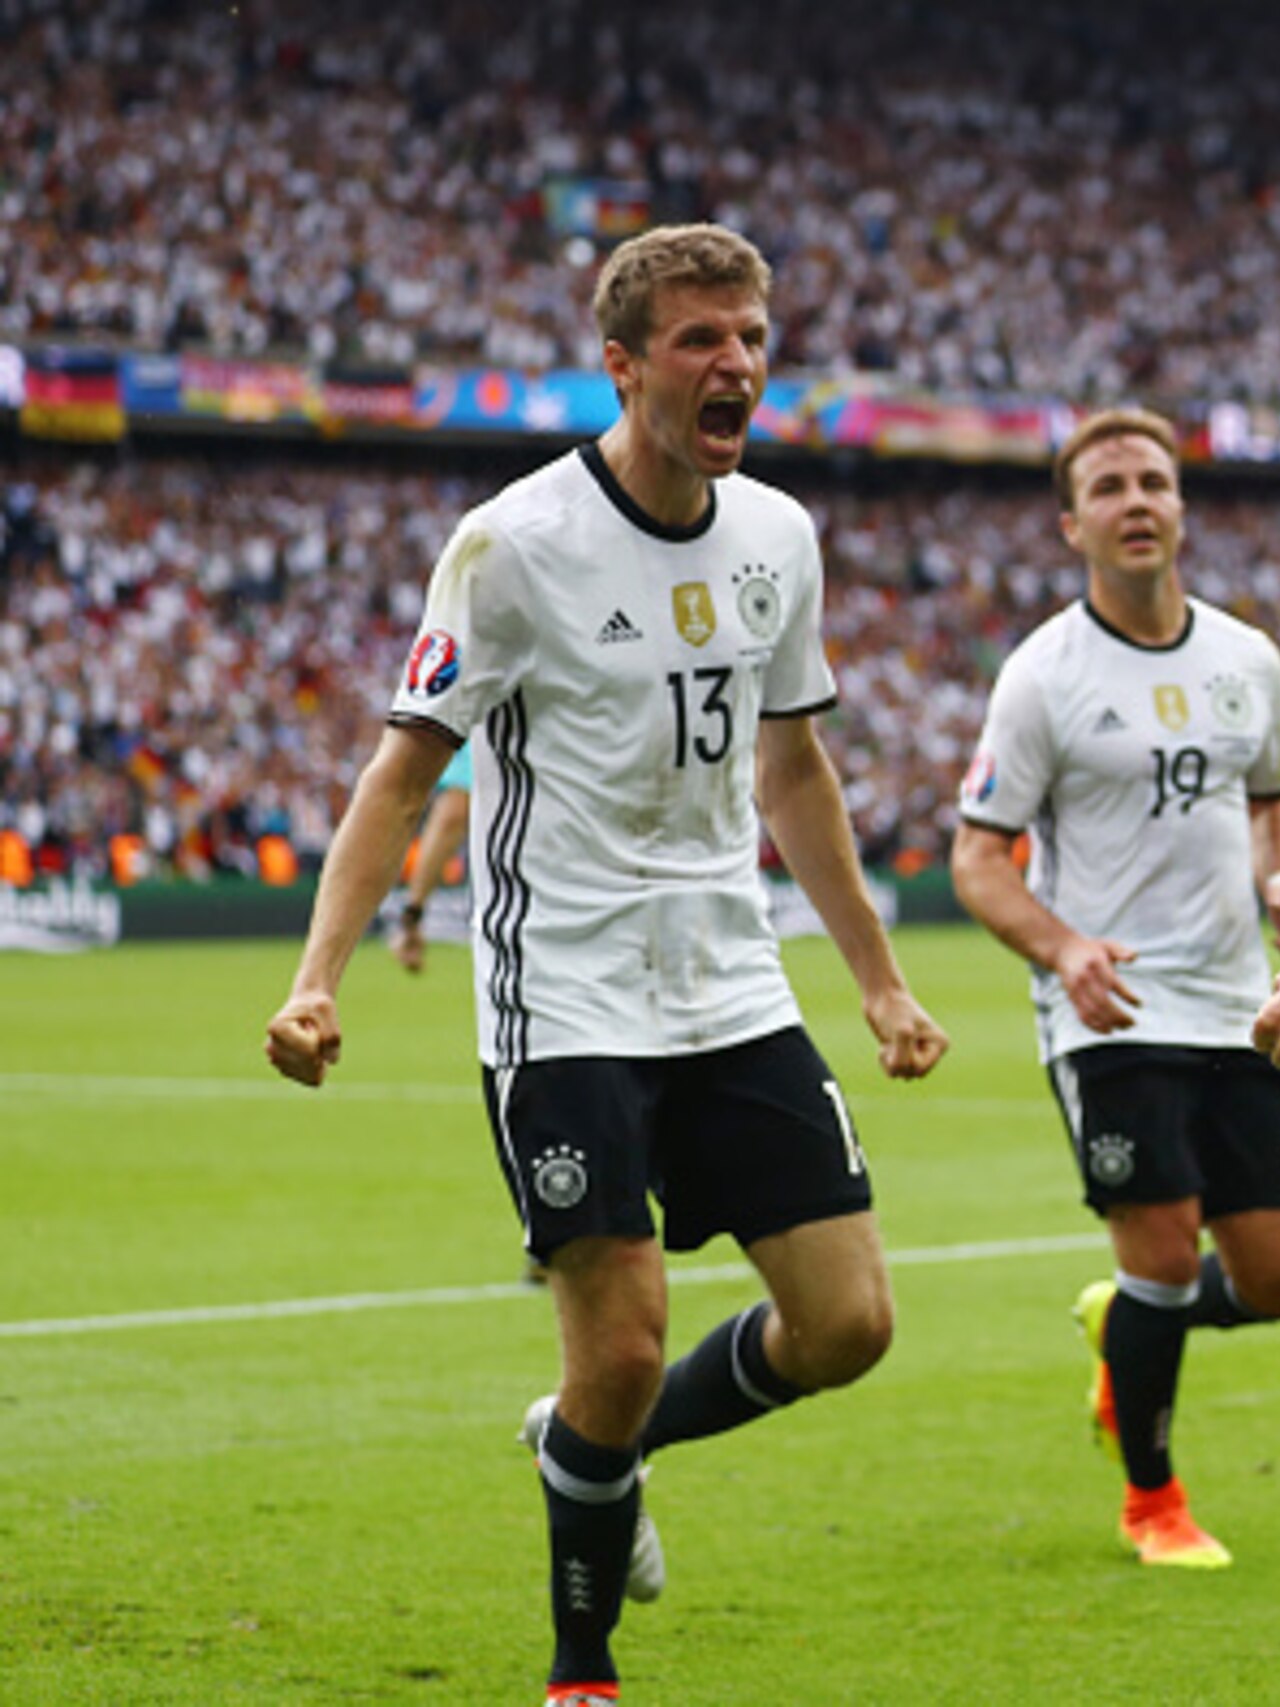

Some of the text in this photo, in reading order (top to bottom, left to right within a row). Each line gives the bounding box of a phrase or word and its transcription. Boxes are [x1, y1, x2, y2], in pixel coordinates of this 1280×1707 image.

[667, 667, 733, 768] 13
[1151, 746, 1208, 818] 19
[822, 1081, 868, 1174] 1
